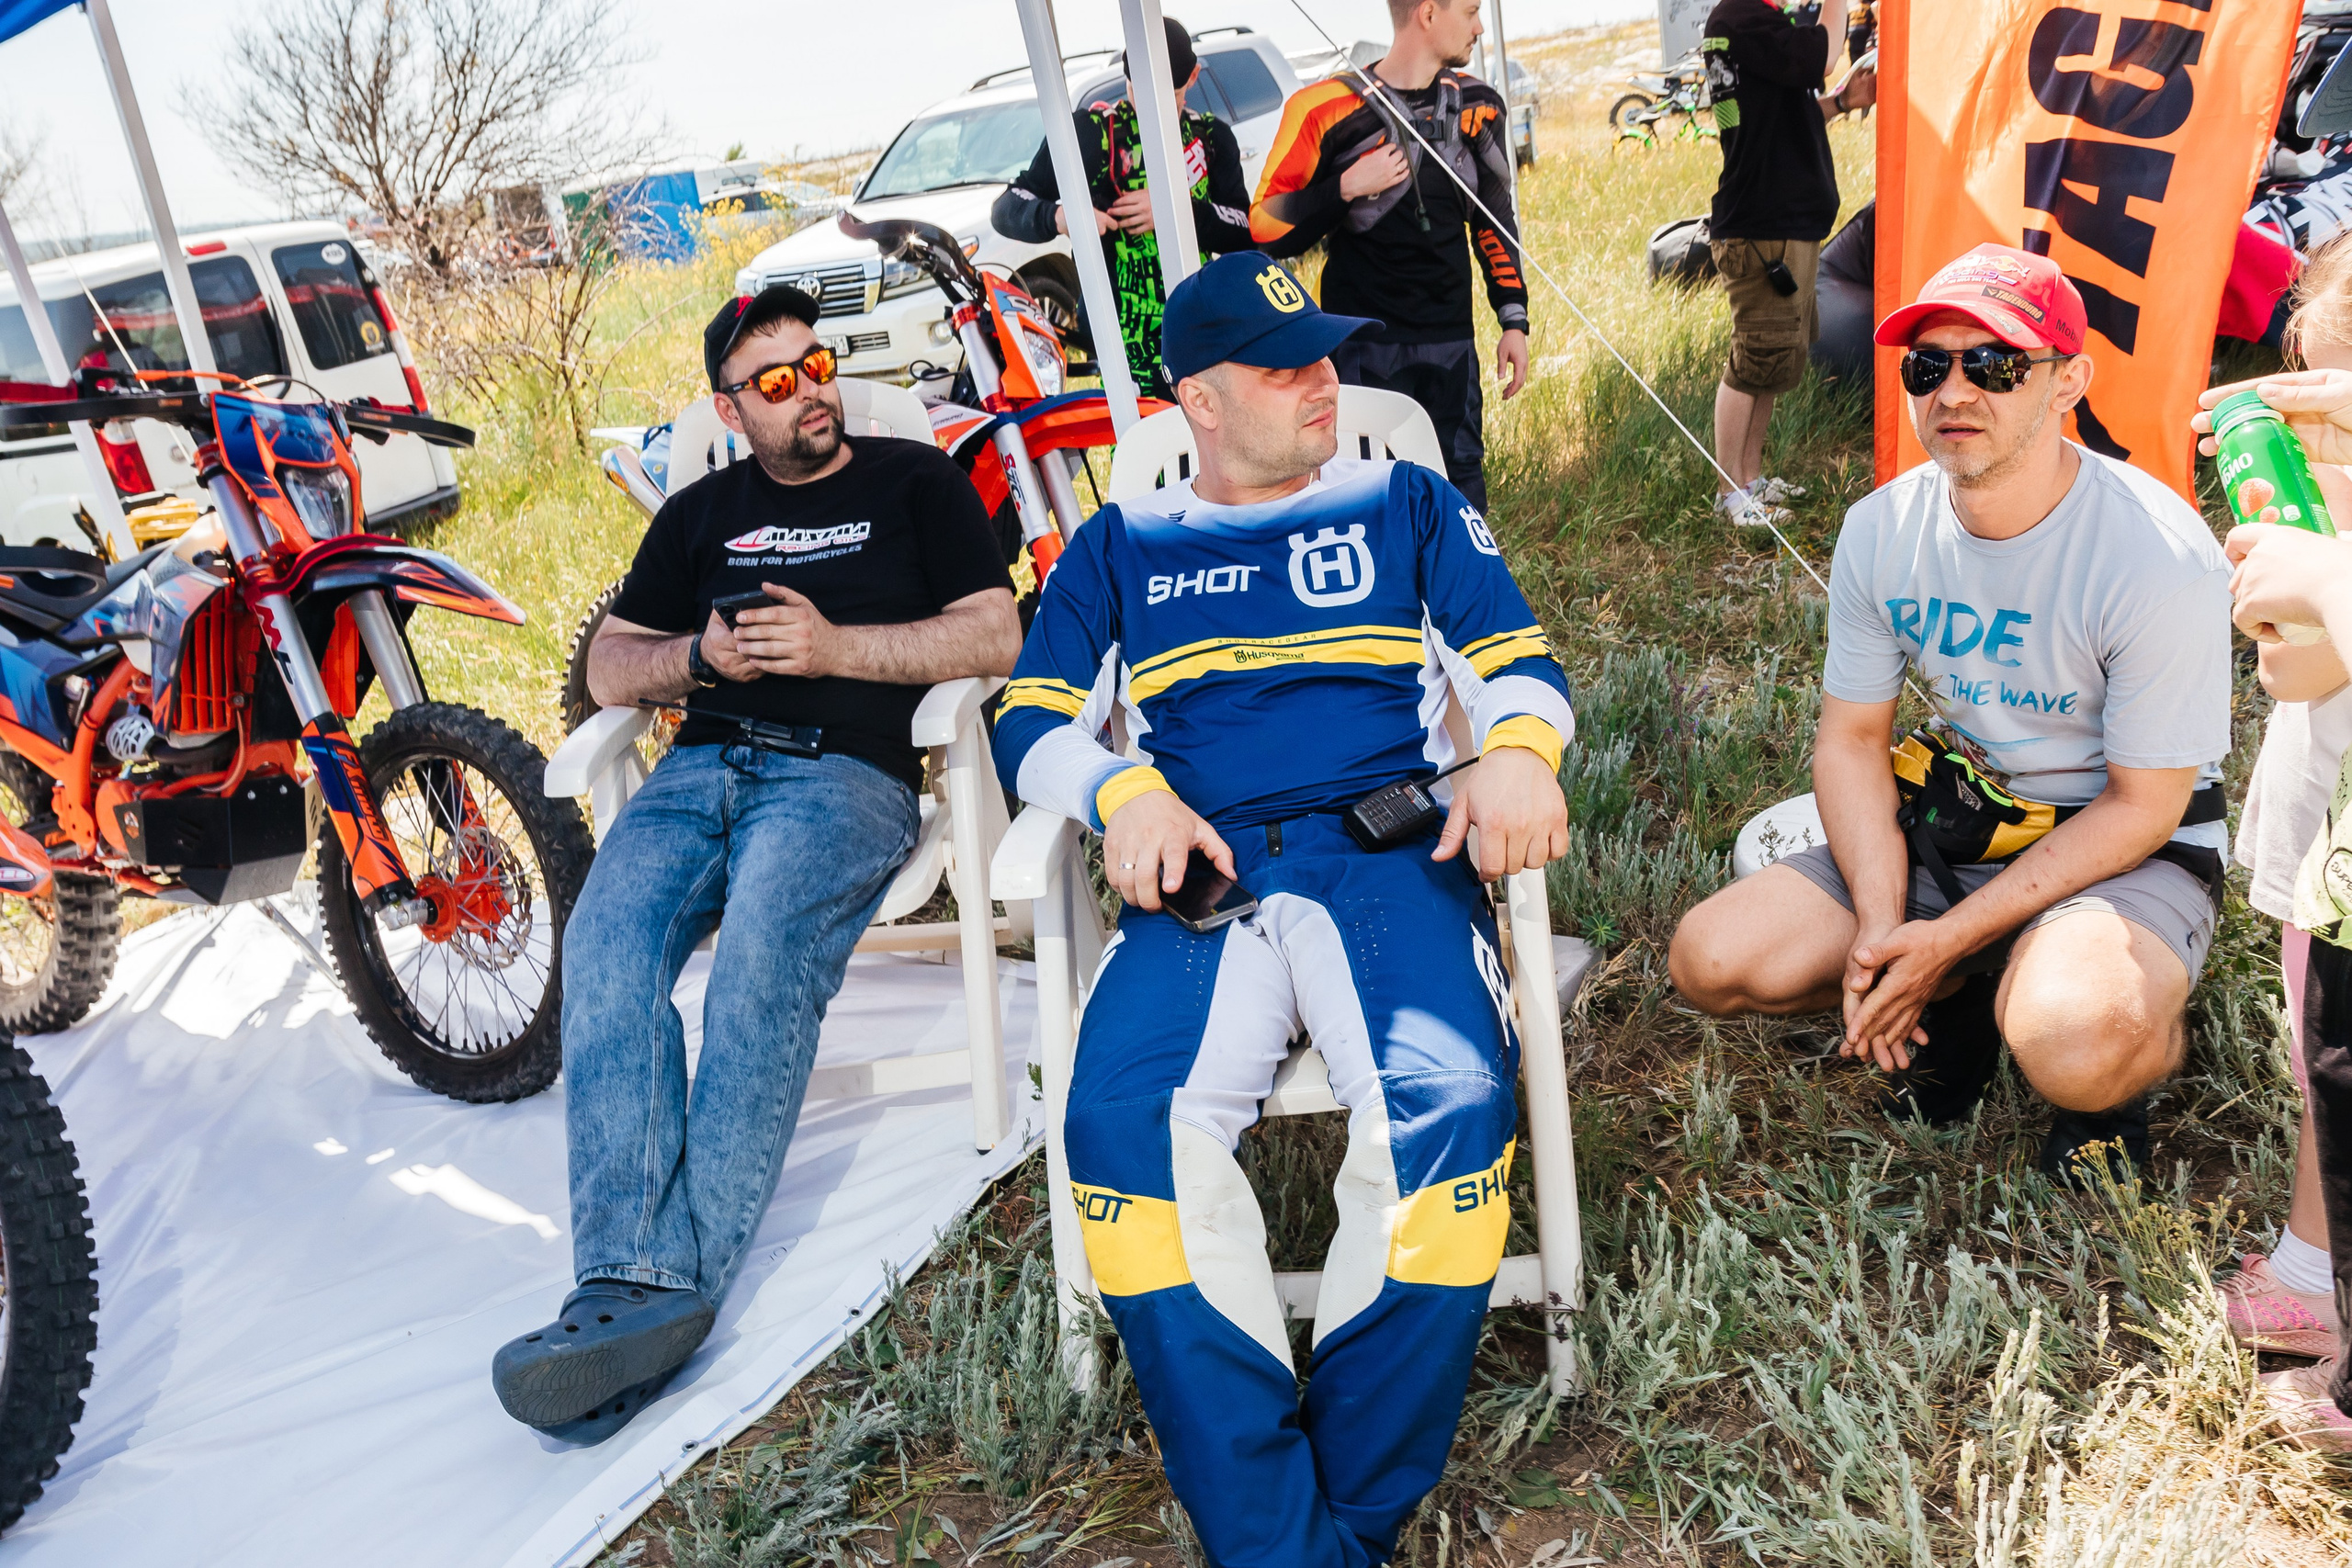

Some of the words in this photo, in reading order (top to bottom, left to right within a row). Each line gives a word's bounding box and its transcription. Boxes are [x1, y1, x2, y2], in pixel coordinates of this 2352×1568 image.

[2020, 0, 2210, 356] TAG
[1995, 289, 2043, 320] TAGENDURO
[728, 557, 759, 567] BORN
[761, 556, 783, 566] FOR
[786, 544, 863, 565] MOTORCYCLES
[1147, 564, 1261, 605] SHOT
[1885, 597, 2031, 668] RIDE
[1950, 674, 1993, 705] THE
[1999, 681, 2078, 715] WAVE
[1453, 1164, 1509, 1213] SH
